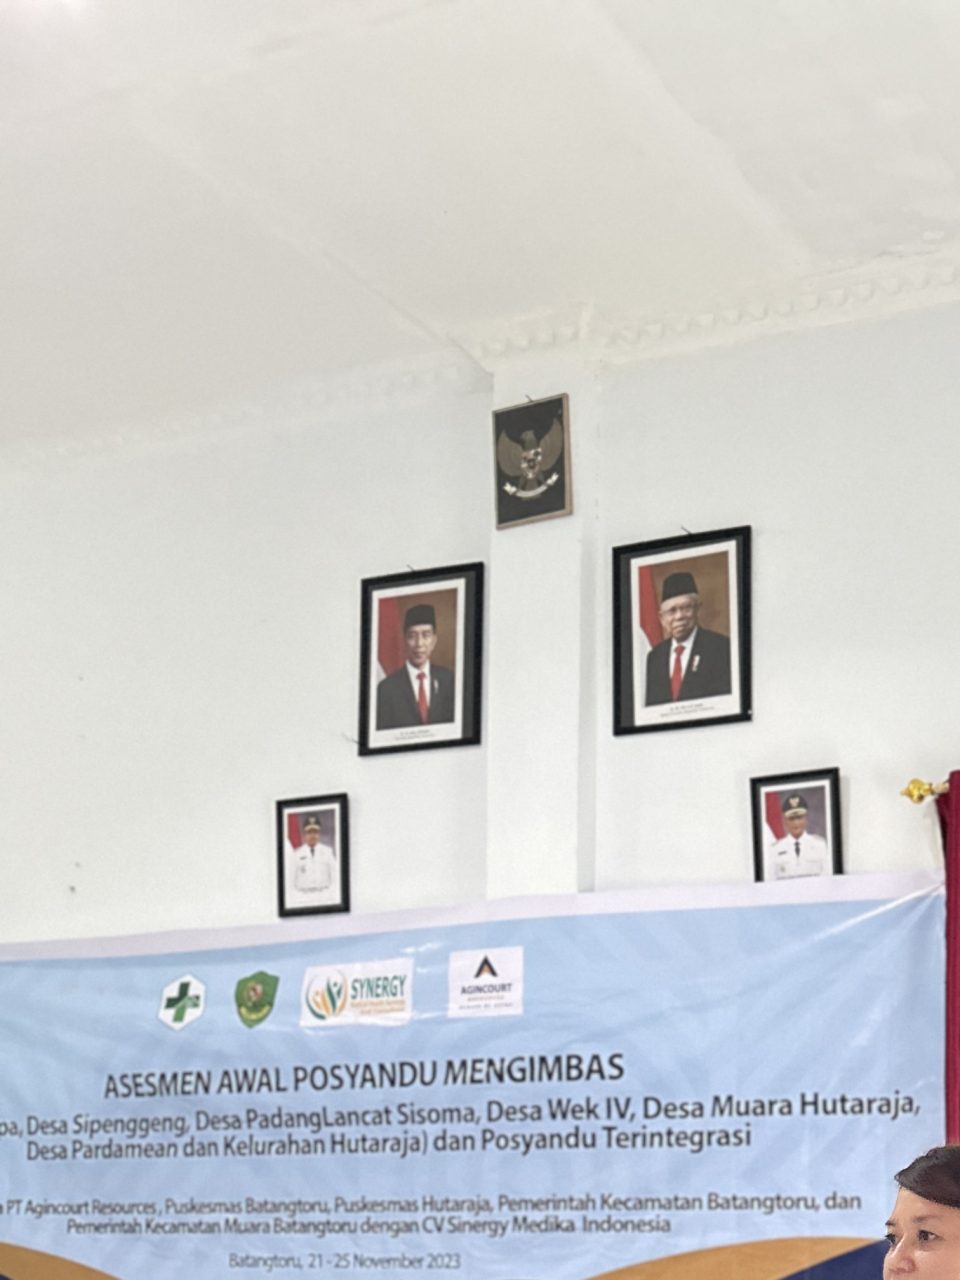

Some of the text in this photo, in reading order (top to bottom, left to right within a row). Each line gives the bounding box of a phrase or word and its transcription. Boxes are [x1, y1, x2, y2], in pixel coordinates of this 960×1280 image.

[351, 975, 407, 1000] SYNERGY
[104, 1053, 624, 1099] ASESMEN AWAL POSYANDU MENGIMBAS
[27, 1115, 68, 1135] Desa
[73, 1114, 190, 1138] Sipenggeng,
[196, 1110, 242, 1131] Desa
[246, 1105, 391, 1133] PadangLancat
[397, 1102, 480, 1125] Sisoma,
[487, 1100, 542, 1122] Desa
[548, 1096, 600, 1120] Wek
[606, 1096, 635, 1122] IV,
[643, 1096, 704, 1119] Desa
[711, 1095, 793, 1117] Muara
[799, 1090, 921, 1120] Hutaraja,
[27, 1123, 751, 1161] Desa Pardamean dan Kelurahan Hutaraja) dan Posyandu Terintegrasi
[6, 1199, 22, 1215] PT
[25, 1198, 89, 1219] Agincourt
[165, 1197, 242, 1215] Puskesmas
[335, 1196, 418, 1213] Puskesmas
[422, 1194, 494, 1216] Hutaraja,
[499, 1193, 596, 1213] Pemerintah
[601, 1193, 702, 1212] Kecamatan
[707, 1193, 819, 1214] Batangtoru,
[825, 1191, 861, 1210] dan
[67, 1215, 671, 1238] Pemerintah Kecamatan Muara Batangtoru dengan CV Sinergy Medika Indonesia
[308, 1252, 323, 1269] 21
[333, 1252, 350, 1269] 25
[353, 1252, 424, 1269] November
[428, 1252, 461, 1270] 2023
